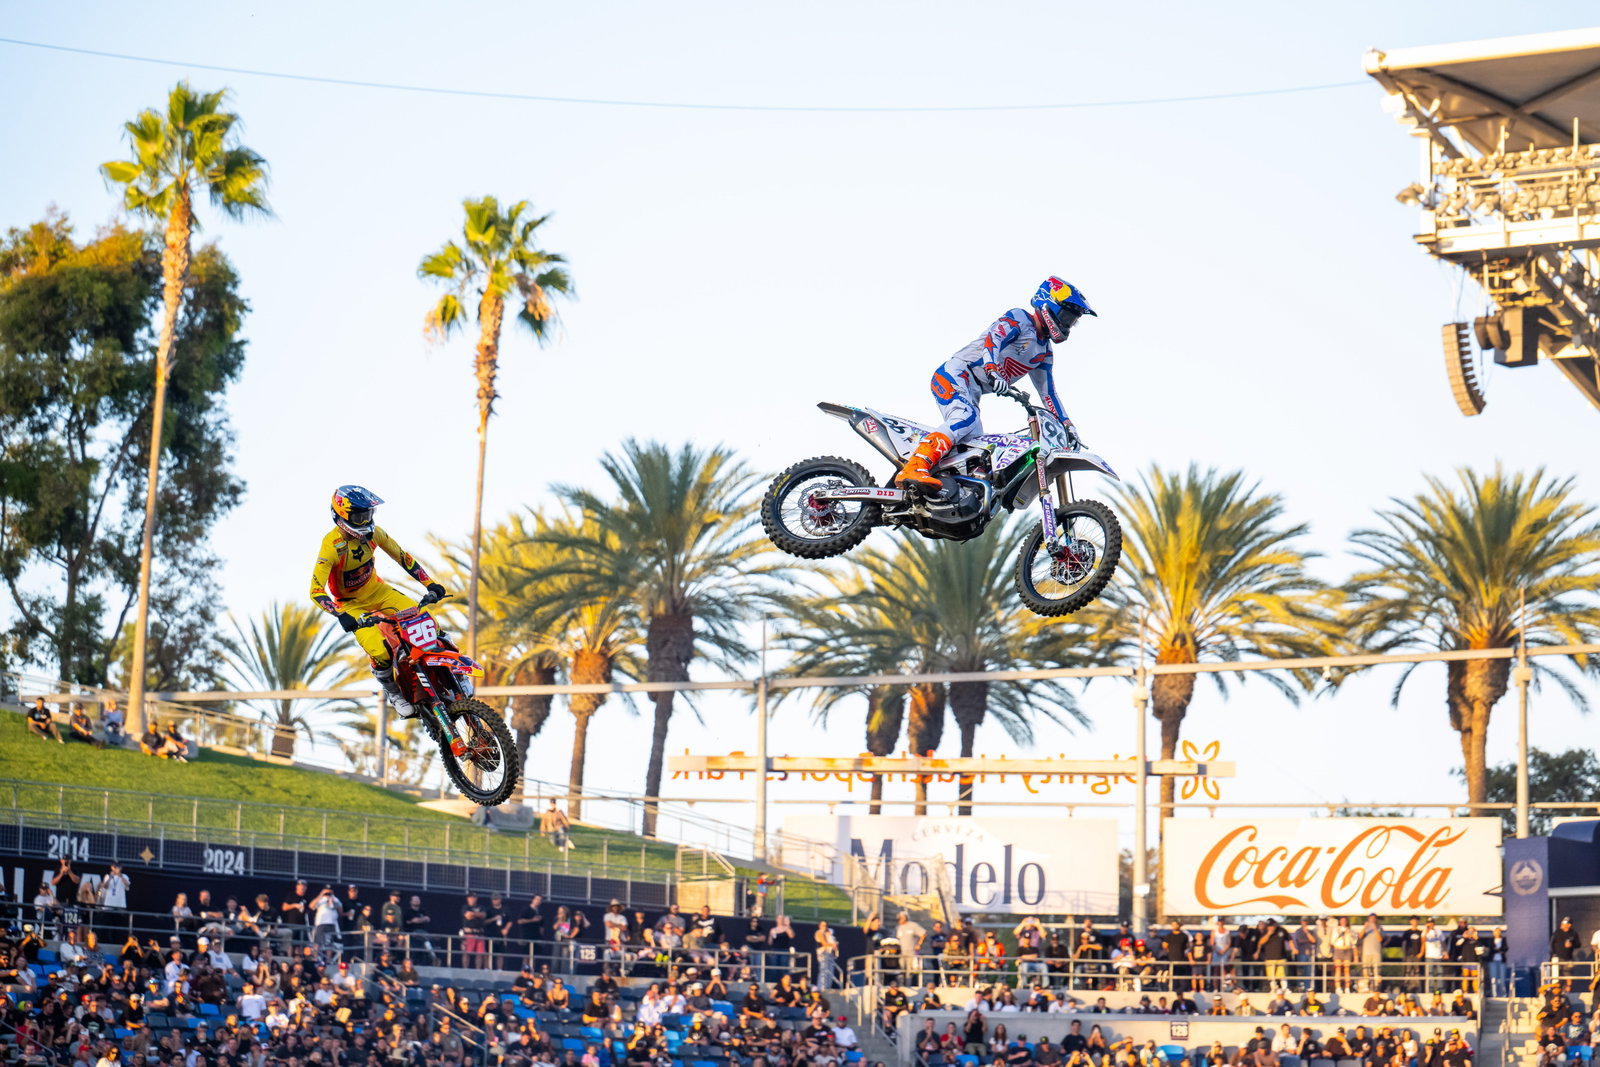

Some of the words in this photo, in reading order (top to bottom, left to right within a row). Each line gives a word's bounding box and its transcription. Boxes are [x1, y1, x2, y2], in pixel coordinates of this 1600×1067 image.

[978, 434, 1031, 451] HONDA
[407, 619, 437, 647] 26
[911, 823, 984, 841] CERVEZA
[48, 834, 91, 863] 2014
[203, 848, 246, 875] 2024
[1194, 824, 1468, 909] Coca-Cola
[579, 948, 596, 961] 125
